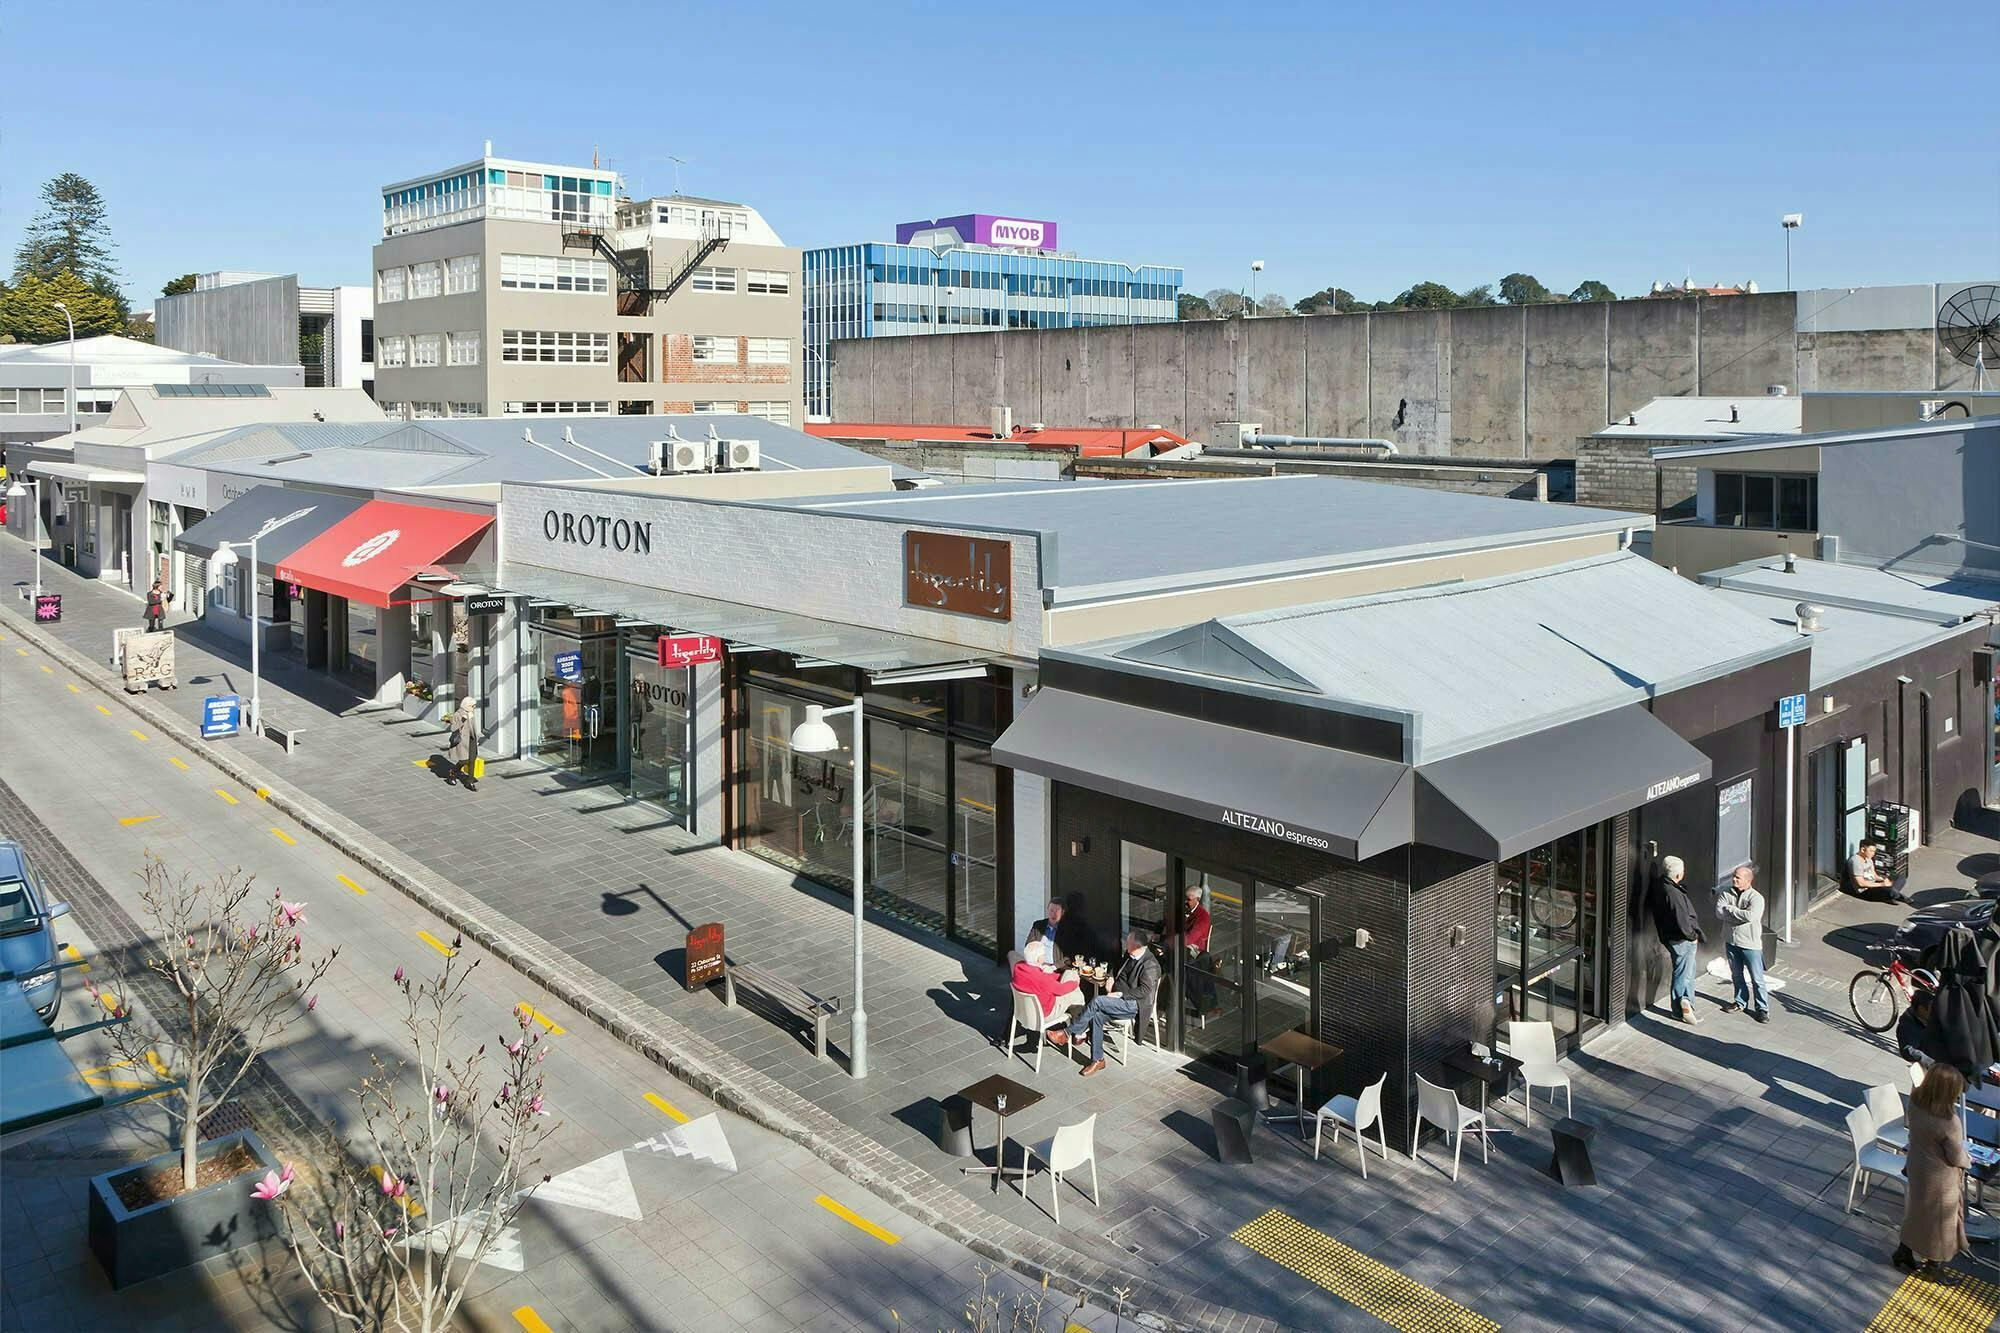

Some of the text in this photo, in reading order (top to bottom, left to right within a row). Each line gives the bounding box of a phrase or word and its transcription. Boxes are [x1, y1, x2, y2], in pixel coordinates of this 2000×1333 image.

[995, 225, 1040, 241] MYOB
[543, 509, 652, 555] OROTON
[910, 543, 1007, 614] tigerlily
[470, 600, 503, 609] OROTON
[671, 637, 716, 664] tigerlily
[160, 663, 171, 676] G
[1647, 776, 1680, 800] ALTEZANO
[1222, 810, 1329, 849] ALTEZANO espresso
